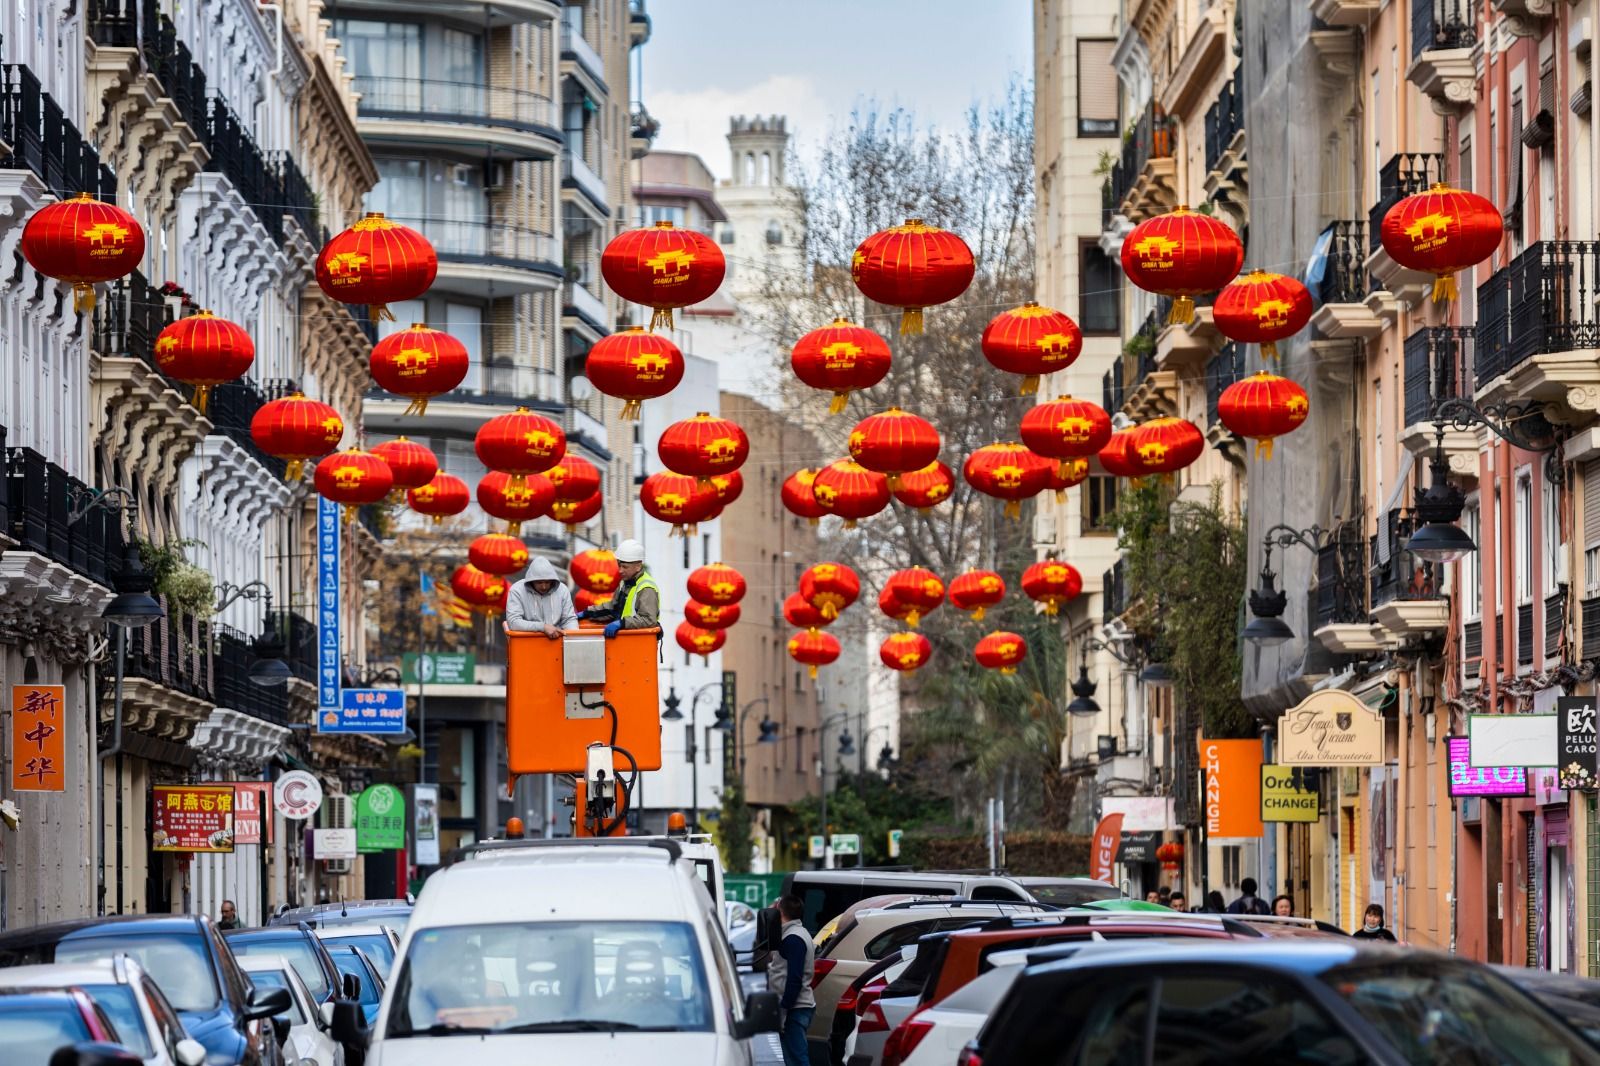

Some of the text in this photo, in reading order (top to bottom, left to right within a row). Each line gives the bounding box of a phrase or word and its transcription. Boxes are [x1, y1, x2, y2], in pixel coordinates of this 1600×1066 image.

[1567, 704, 1596, 734] 欧
[18, 690, 60, 785] 新中华
[1565, 745, 1597, 754] CARO
[1206, 745, 1220, 833] CHANGE
[1264, 798, 1317, 809] CHANGE
